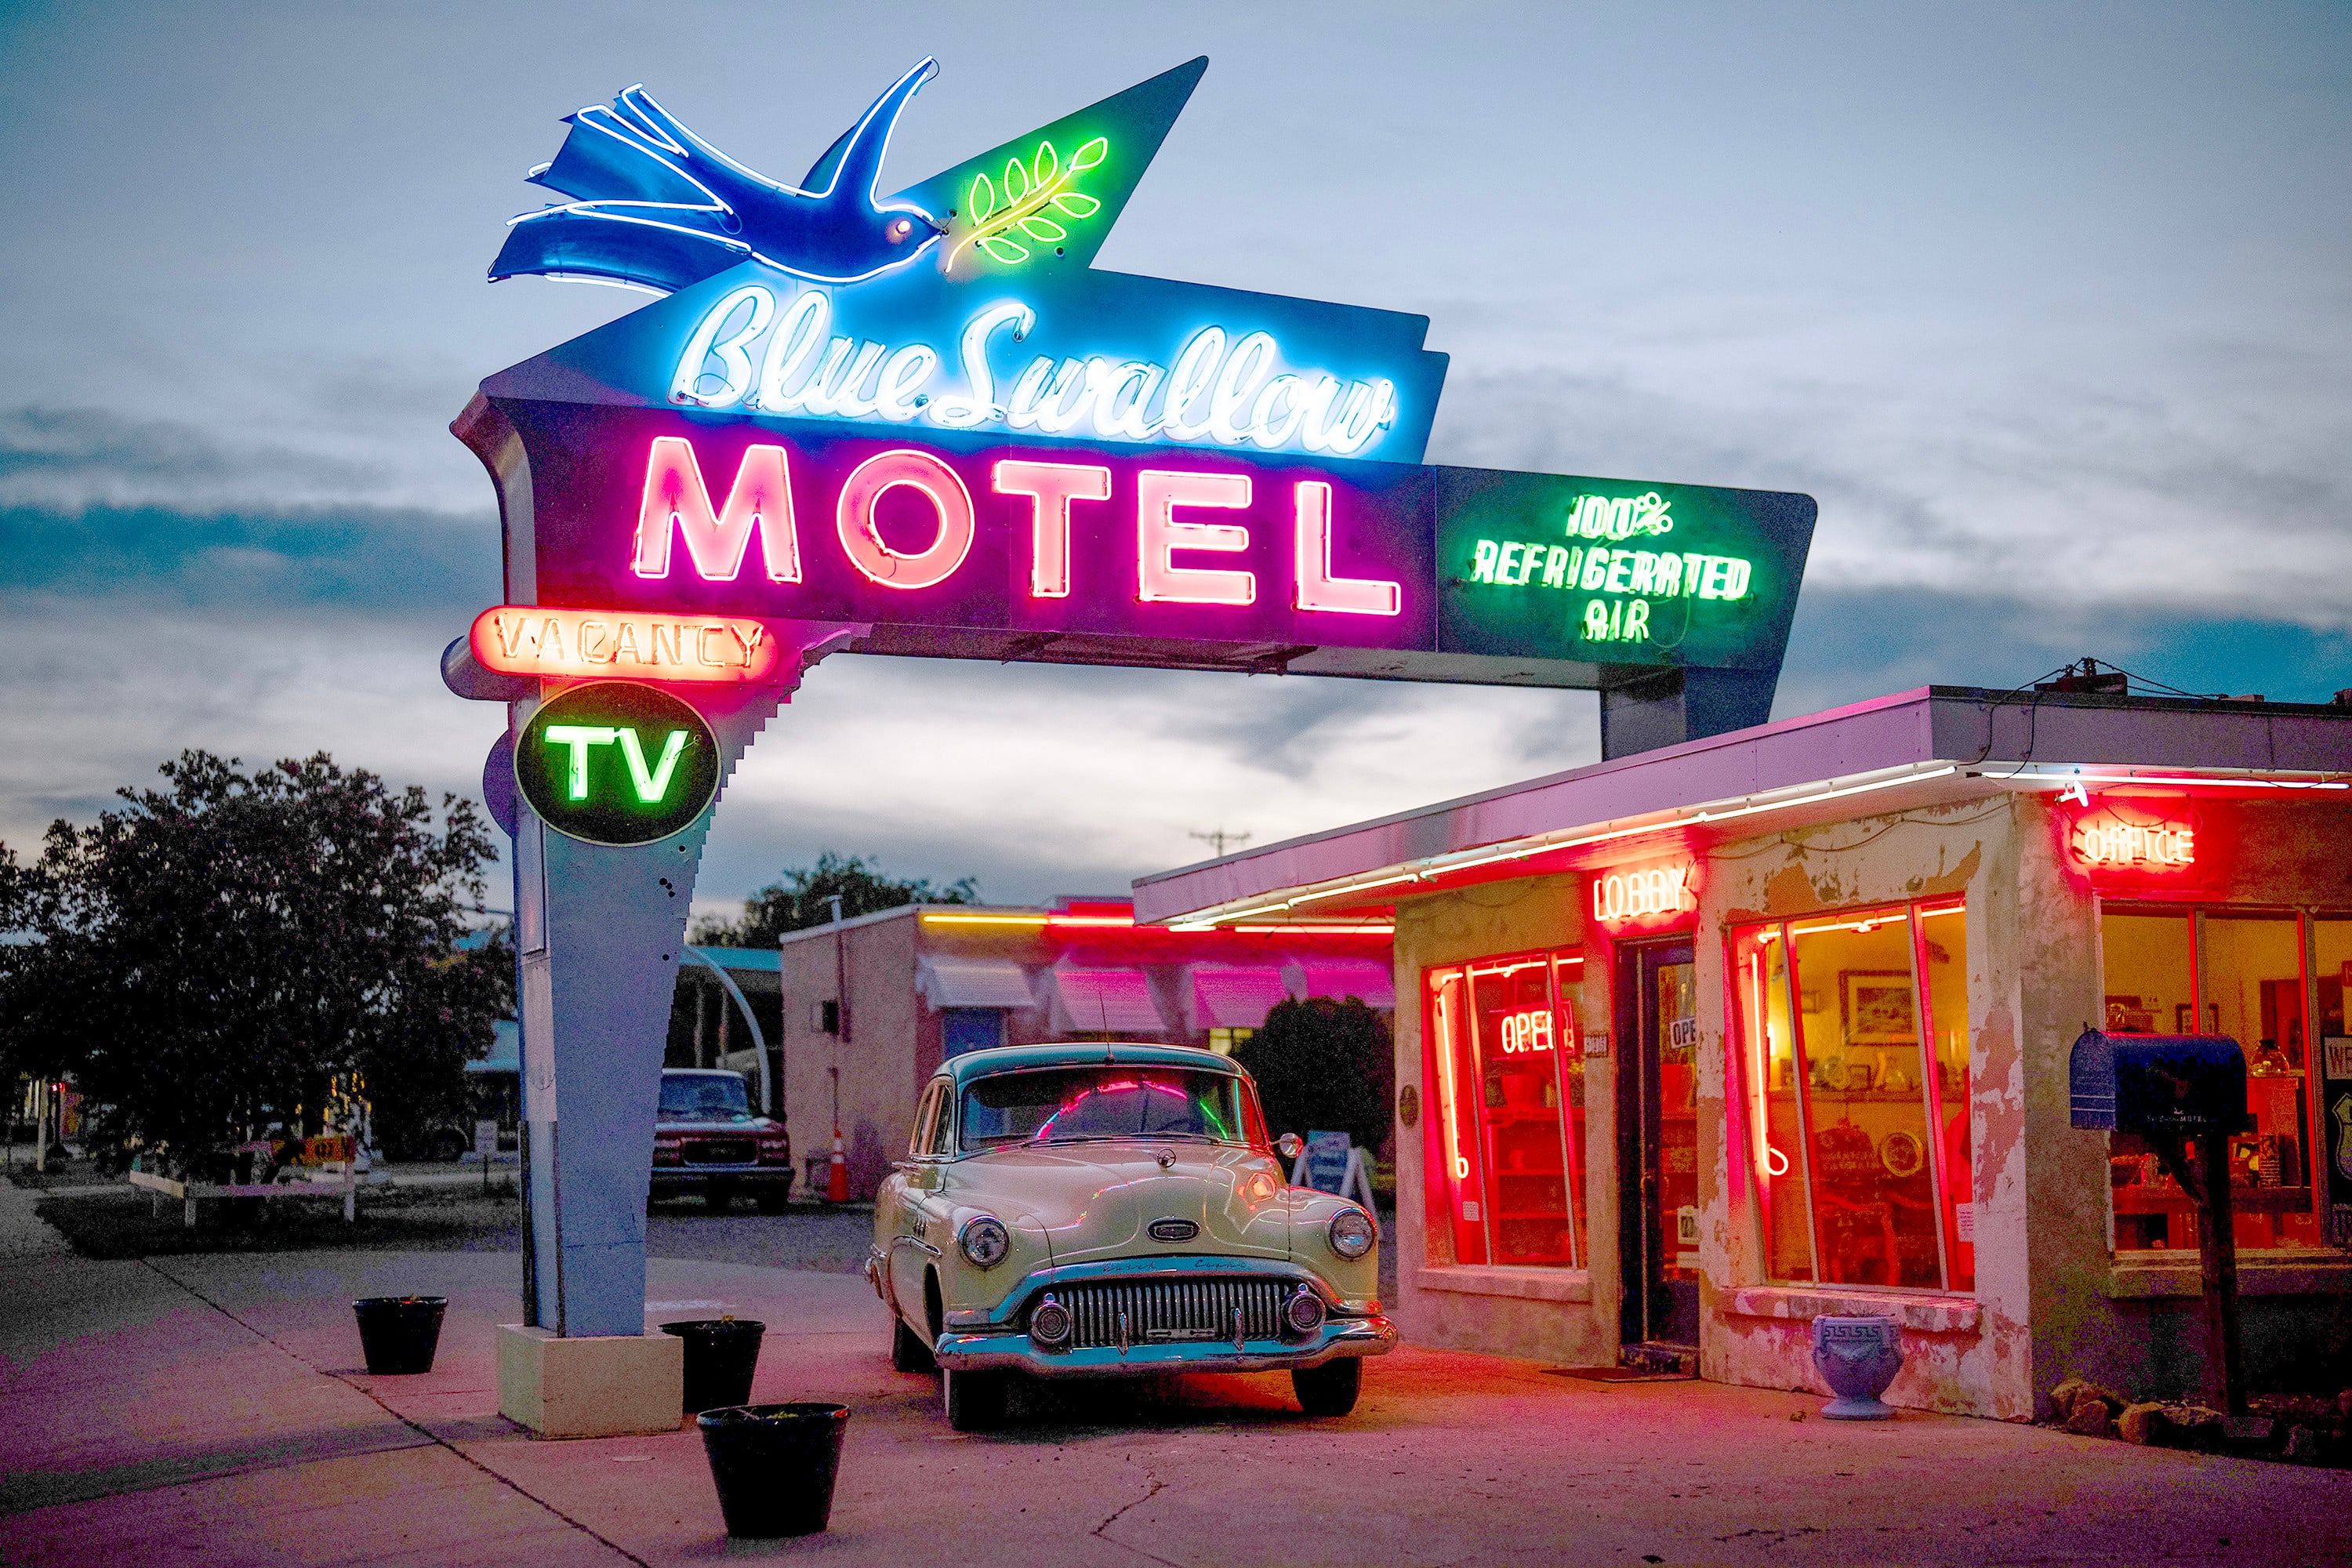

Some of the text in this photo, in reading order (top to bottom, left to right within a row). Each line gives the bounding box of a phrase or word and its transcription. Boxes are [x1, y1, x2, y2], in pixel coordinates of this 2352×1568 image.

[666, 285, 1396, 455] Blue Swallow
[632, 436, 1403, 617] MOTEL
[1566, 491, 1675, 539] 100%
[1469, 539, 1752, 601] REFRIGERATED
[495, 615, 764, 668] VACANCY
[1581, 599, 1650, 644] AIR
[545, 725, 689, 804] TV
[2084, 826, 2196, 864] OFFICE
[1593, 866, 1687, 922] LOBBY
